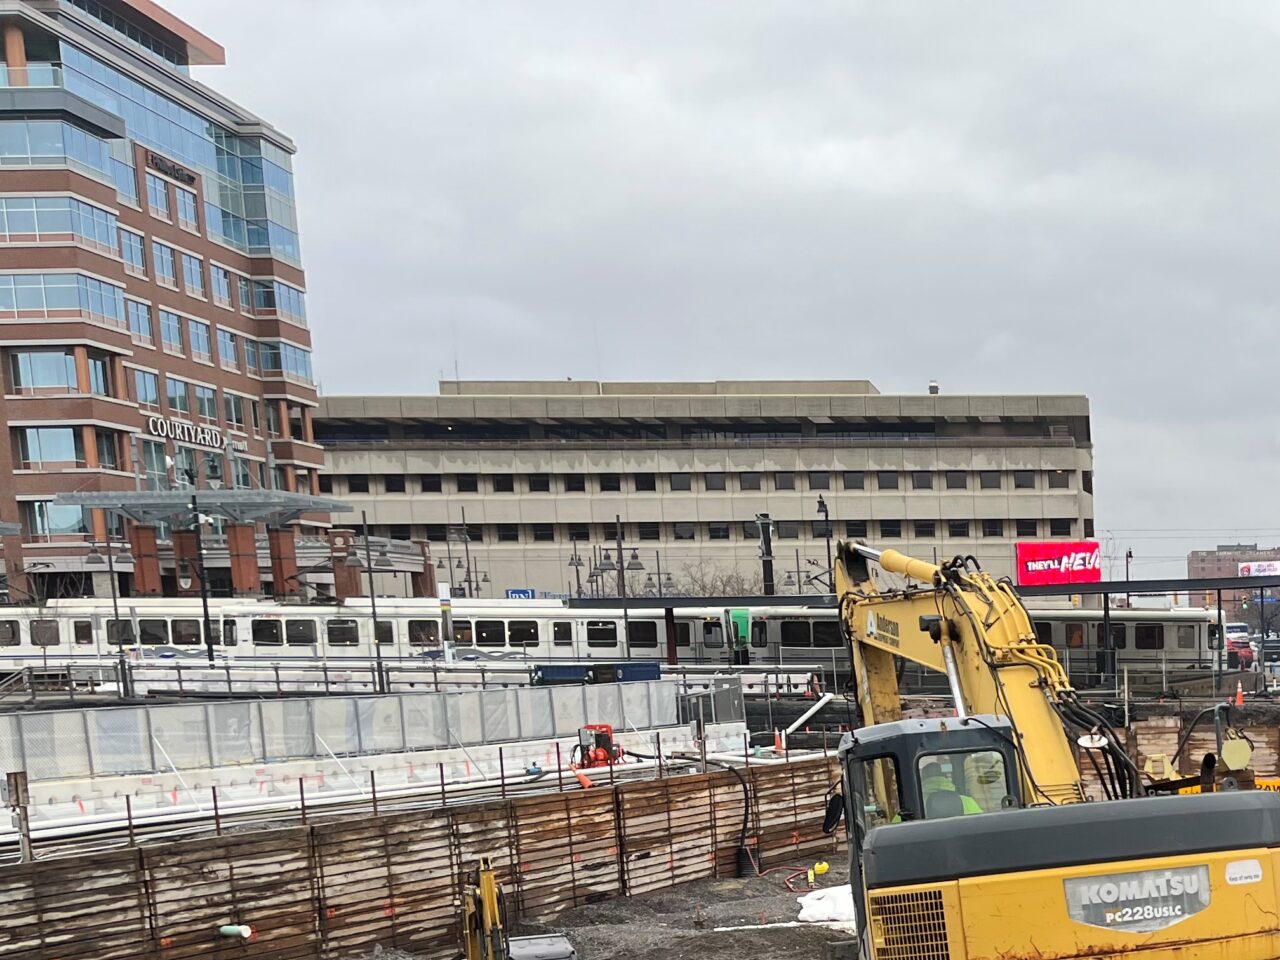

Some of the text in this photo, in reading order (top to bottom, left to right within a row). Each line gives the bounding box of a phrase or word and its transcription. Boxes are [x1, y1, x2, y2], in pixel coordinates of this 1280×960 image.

[149, 416, 221, 448] COURTYARD
[1026, 559, 1060, 571] THEY'LL
[1081, 872, 1200, 905] KOMATSU
[1106, 905, 1182, 924] PC228USLC
